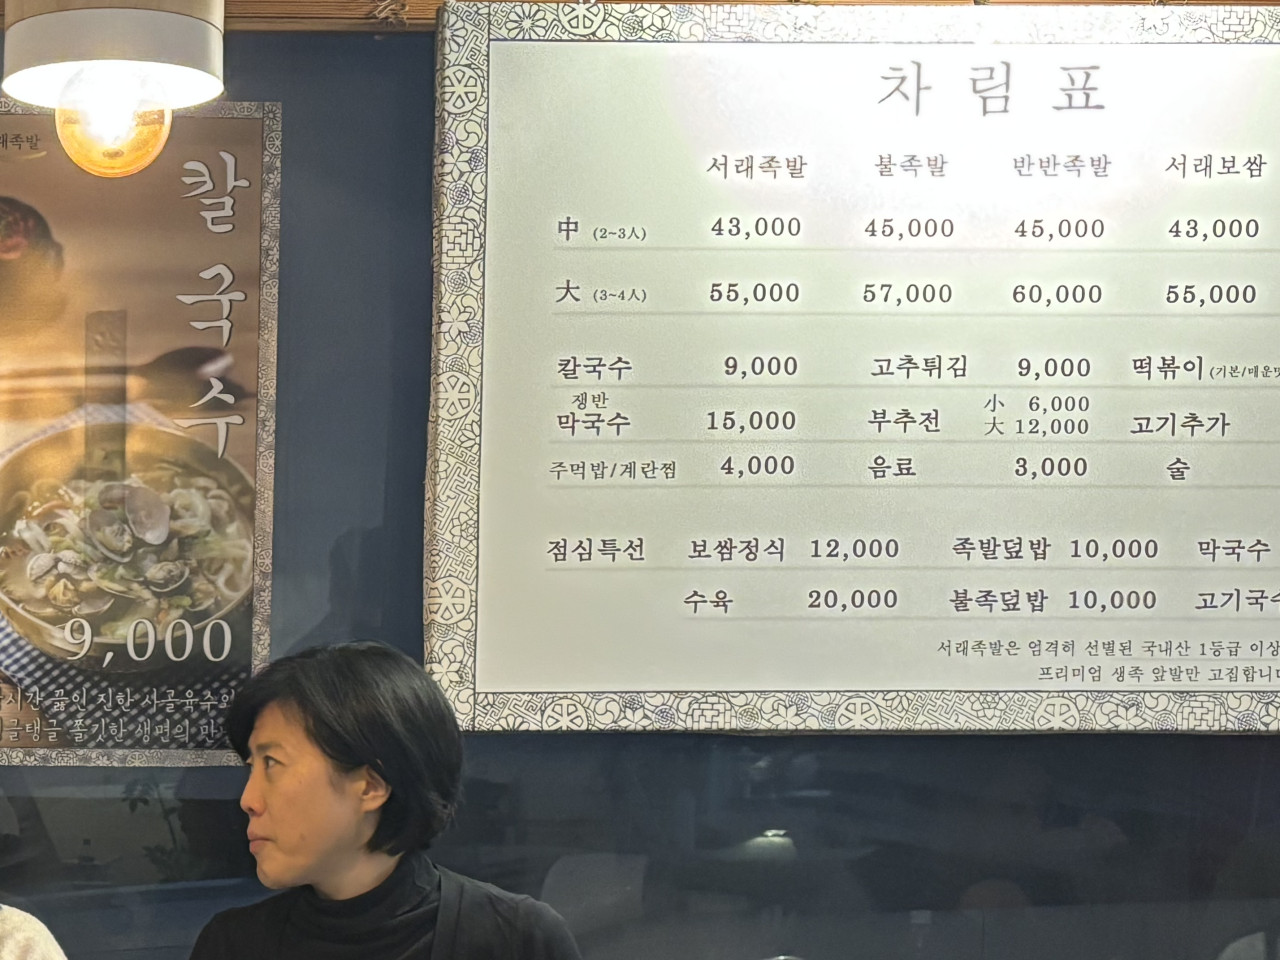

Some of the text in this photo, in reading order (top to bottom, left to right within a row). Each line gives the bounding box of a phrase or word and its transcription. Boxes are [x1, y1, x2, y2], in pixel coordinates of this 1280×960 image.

[706, 154, 808, 180] 서래족발
[874, 153, 949, 178] 불족발
[1013, 153, 1112, 178] 반반족발
[1165, 153, 1268, 179] 서래보쌈
[557, 216, 579, 242] 中
[710, 216, 801, 241] 43,000
[864, 218, 954, 241] 45,000
[1014, 218, 1105, 242] 45,000
[1168, 218, 1260, 242] 43,000
[555, 279, 581, 303] 大
[709, 282, 800, 306] 55,000
[863, 283, 952, 307] 57,000
[1012, 284, 1102, 308] 60,000
[1166, 284, 1257, 308] 55,000
[172, 151, 250, 459] 칼국수
[557, 355, 798, 381] 칼국수 9,000
[870, 354, 1091, 381] 고추튀김 9,000
[1132, 355, 1203, 381] 떡볶이
[572, 391, 609, 410] 쟁반
[983, 393, 1090, 415] 小 6,000
[557, 410, 796, 437] 막국수 15,000
[867, 408, 941, 434] 부추전
[984, 416, 1089, 438] 大 12,000
[1129, 412, 1231, 437] 고기추가
[549, 455, 795, 481] 주먹밥/계란찜 4,000
[867, 455, 1088, 481] 음료 3,000
[1166, 457, 1191, 481] 술
[546, 537, 645, 563] 점심특선
[687, 537, 899, 563] 보쌈정식 12,000
[951, 536, 1159, 562] 족발덮밥 10,000
[1197, 538, 1272, 563] 막국수
[683, 589, 898, 614] 수육 20,000
[948, 588, 1157, 613] 불족덮밥 10,000
[63, 617, 232, 668] 9,000
[937, 639, 1021, 657] 서래족발은
[1084, 639, 1133, 657] 선별된
[1141, 640, 1192, 657] 국내산
[1199, 640, 1242, 658] 1등급
[1038, 665, 1102, 683] 프리미엄
[1111, 665, 1144, 683] 생족
[1151, 665, 1201, 683] 앞발만
[98, 687, 134, 712] 진한
[69, 718, 127, 742] 쫄깃한
[135, 718, 189, 743] 생면의
